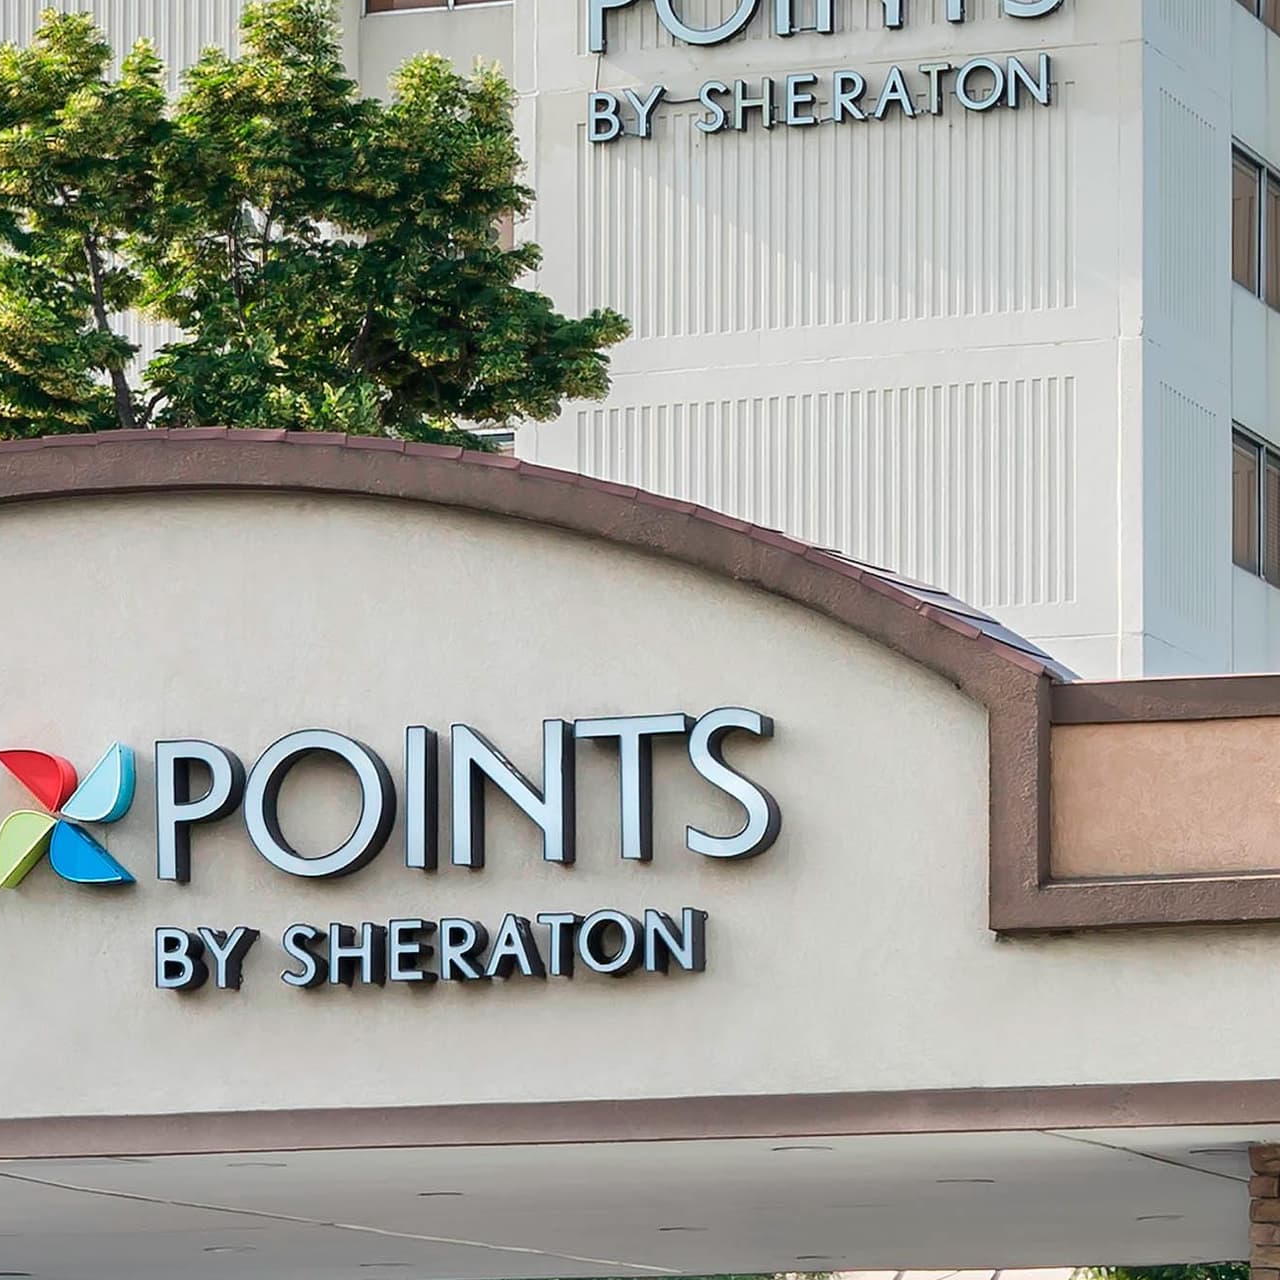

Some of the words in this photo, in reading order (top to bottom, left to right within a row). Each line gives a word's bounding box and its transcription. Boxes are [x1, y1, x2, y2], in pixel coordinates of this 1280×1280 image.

[588, 84, 666, 142] BY
[696, 53, 1052, 133] SHERATON
[155, 706, 781, 882] POINTS
[155, 927, 259, 991] BY
[281, 907, 708, 989] SHERATON
